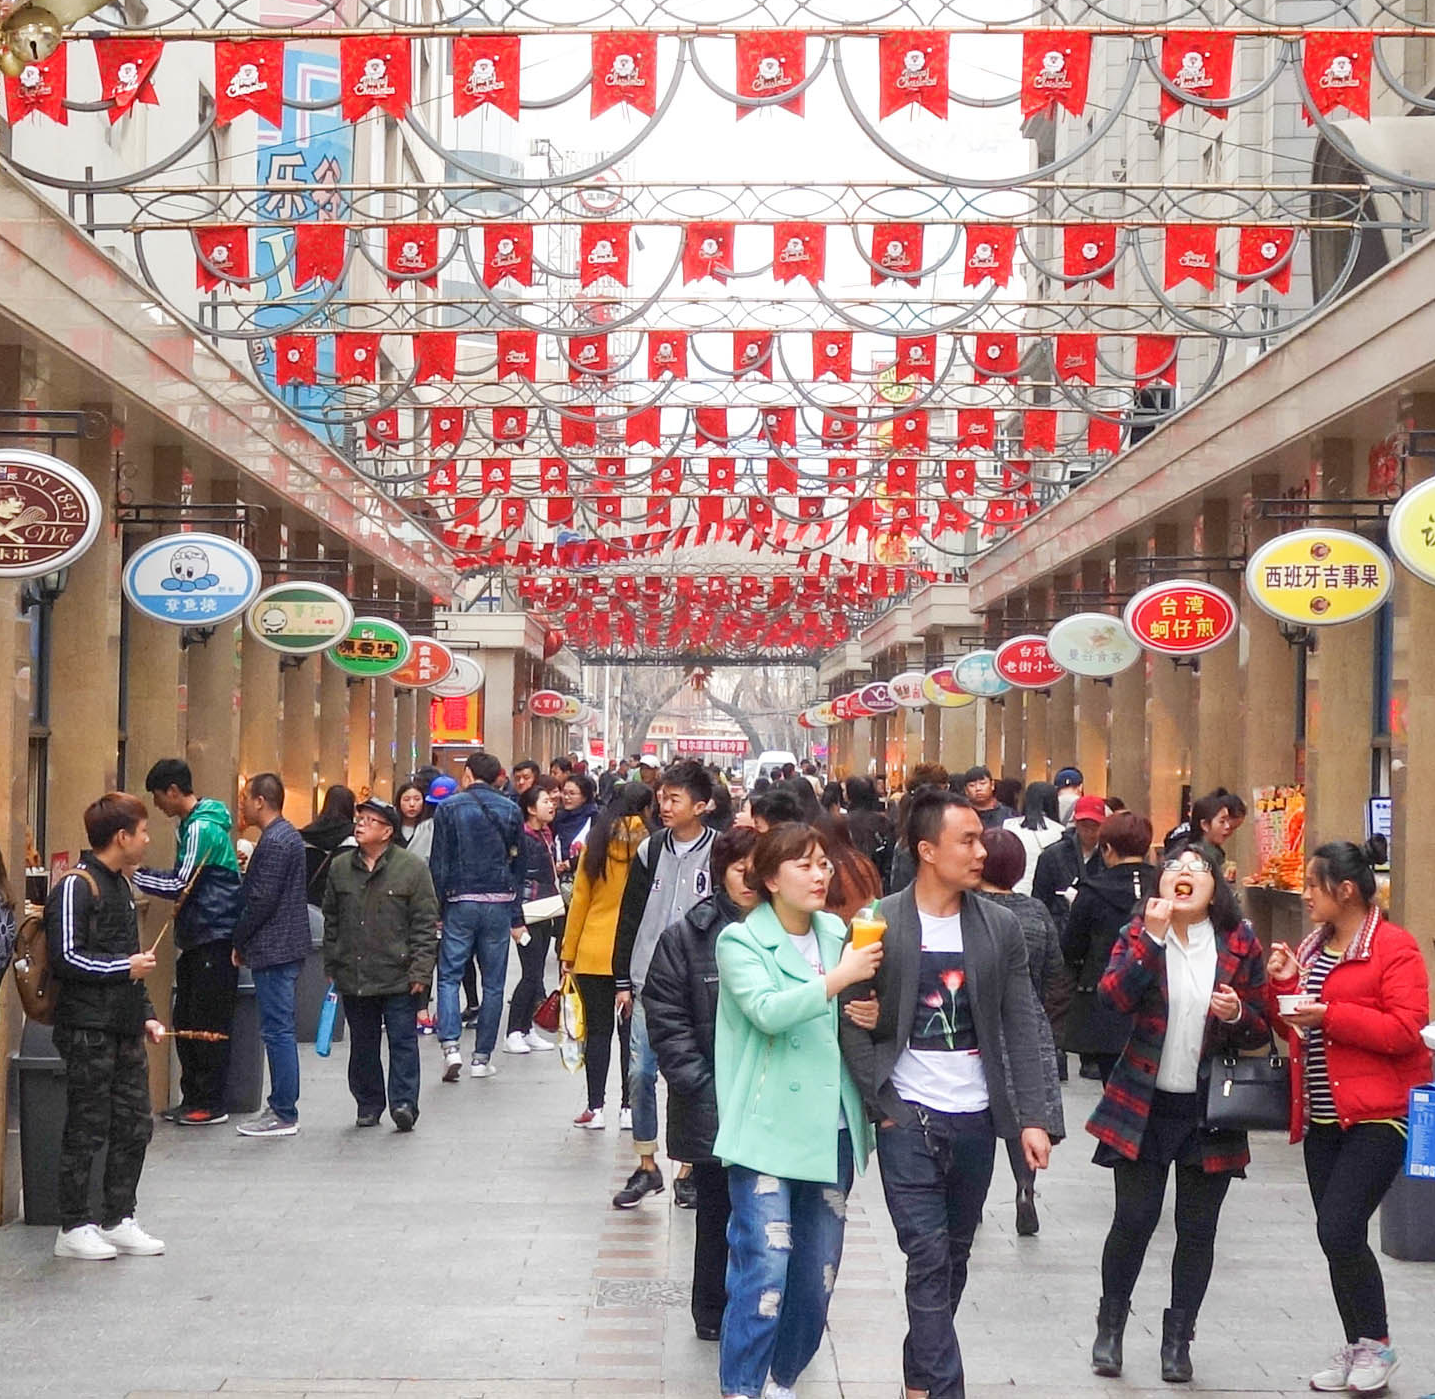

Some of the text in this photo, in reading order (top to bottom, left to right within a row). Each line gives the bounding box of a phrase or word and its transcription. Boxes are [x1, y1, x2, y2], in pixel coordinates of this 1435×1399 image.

[24, 471, 50, 487] IN
[51, 486, 80, 520] 1845
[1264, 564, 1380, 590] 西班牙吉事果
[1159, 595, 1205, 617] 台湾
[1149, 616, 1215, 640] 蚵仔煎
